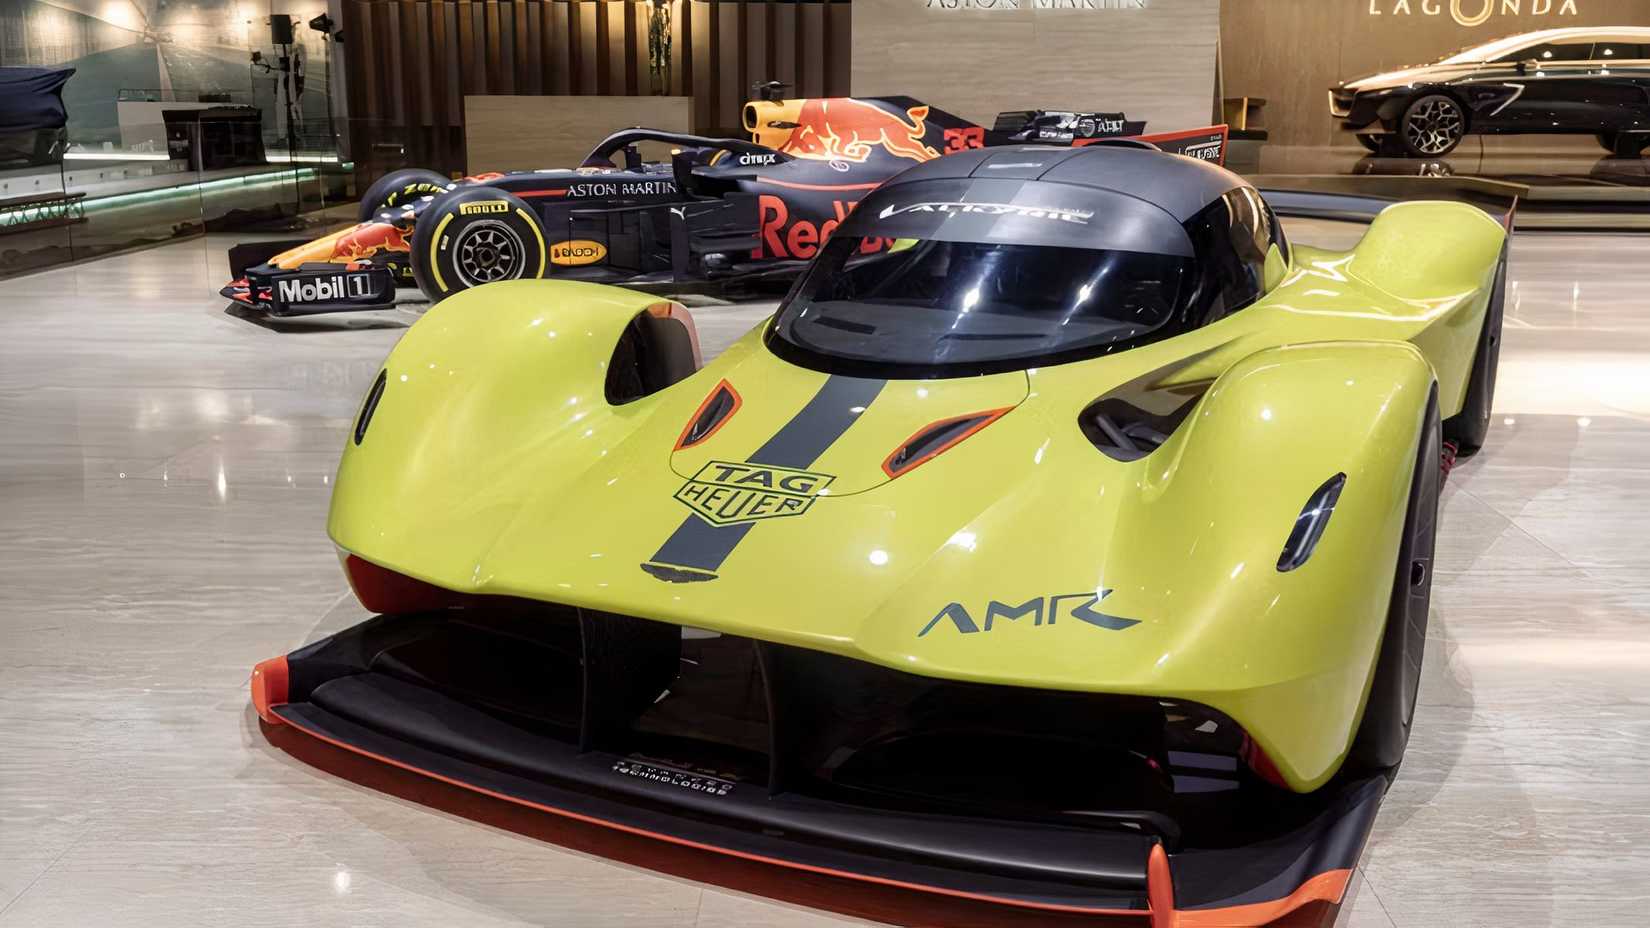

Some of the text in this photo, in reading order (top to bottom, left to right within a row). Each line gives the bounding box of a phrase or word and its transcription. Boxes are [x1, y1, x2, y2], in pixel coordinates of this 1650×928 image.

[1369, 0, 1578, 26] LAGONDA
[567, 181, 677, 197] ASTON MARTIN
[278, 275, 345, 303] Mobil
[715, 465, 819, 493] TAG
[683, 485, 803, 519] HEUER
[917, 588, 1143, 638] AMR
